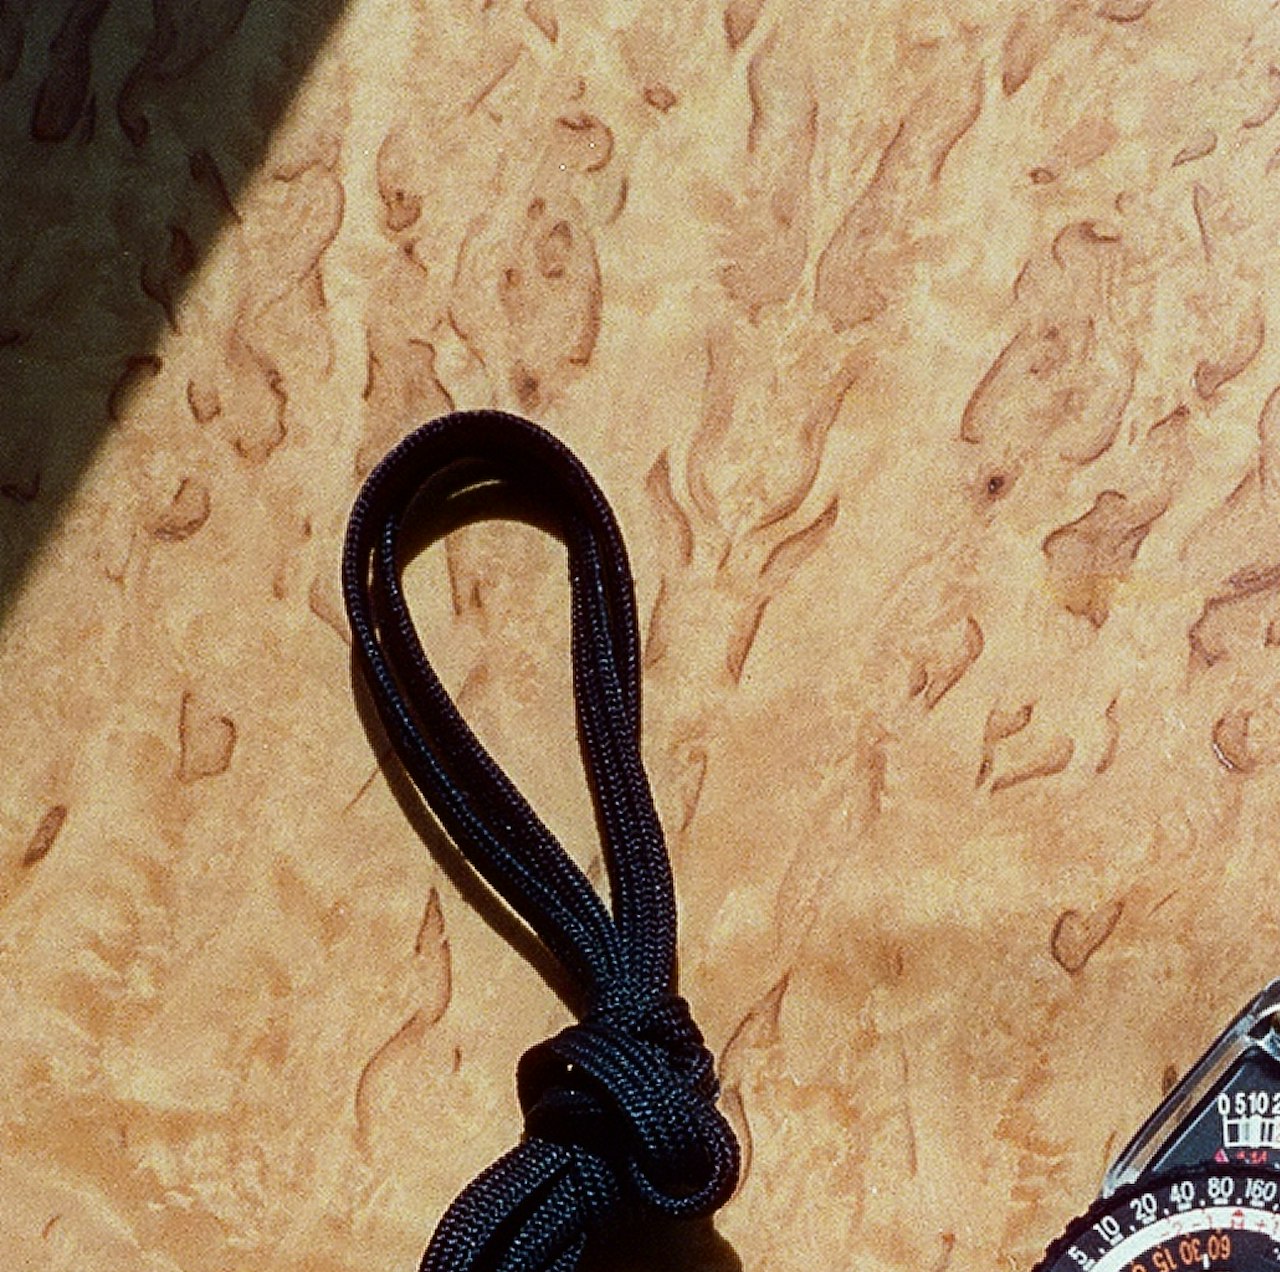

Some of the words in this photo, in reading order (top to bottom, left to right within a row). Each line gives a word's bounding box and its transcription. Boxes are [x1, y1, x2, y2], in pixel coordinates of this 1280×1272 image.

[1217, 1093, 1230, 1115] 0
[1235, 1092, 1246, 1114] 5
[1248, 1092, 1269, 1114] 10
[1068, 1245, 1088, 1266] 5
[1093, 1215, 1120, 1242] 10
[1130, 1193, 1158, 1221] 20
[1170, 1181, 1194, 1203] 40
[1208, 1176, 1234, 1199] 80
[1245, 1177, 1277, 1201] 160
[1178, 1238, 1202, 1266] 30
[1208, 1234, 1231, 1260] 60
